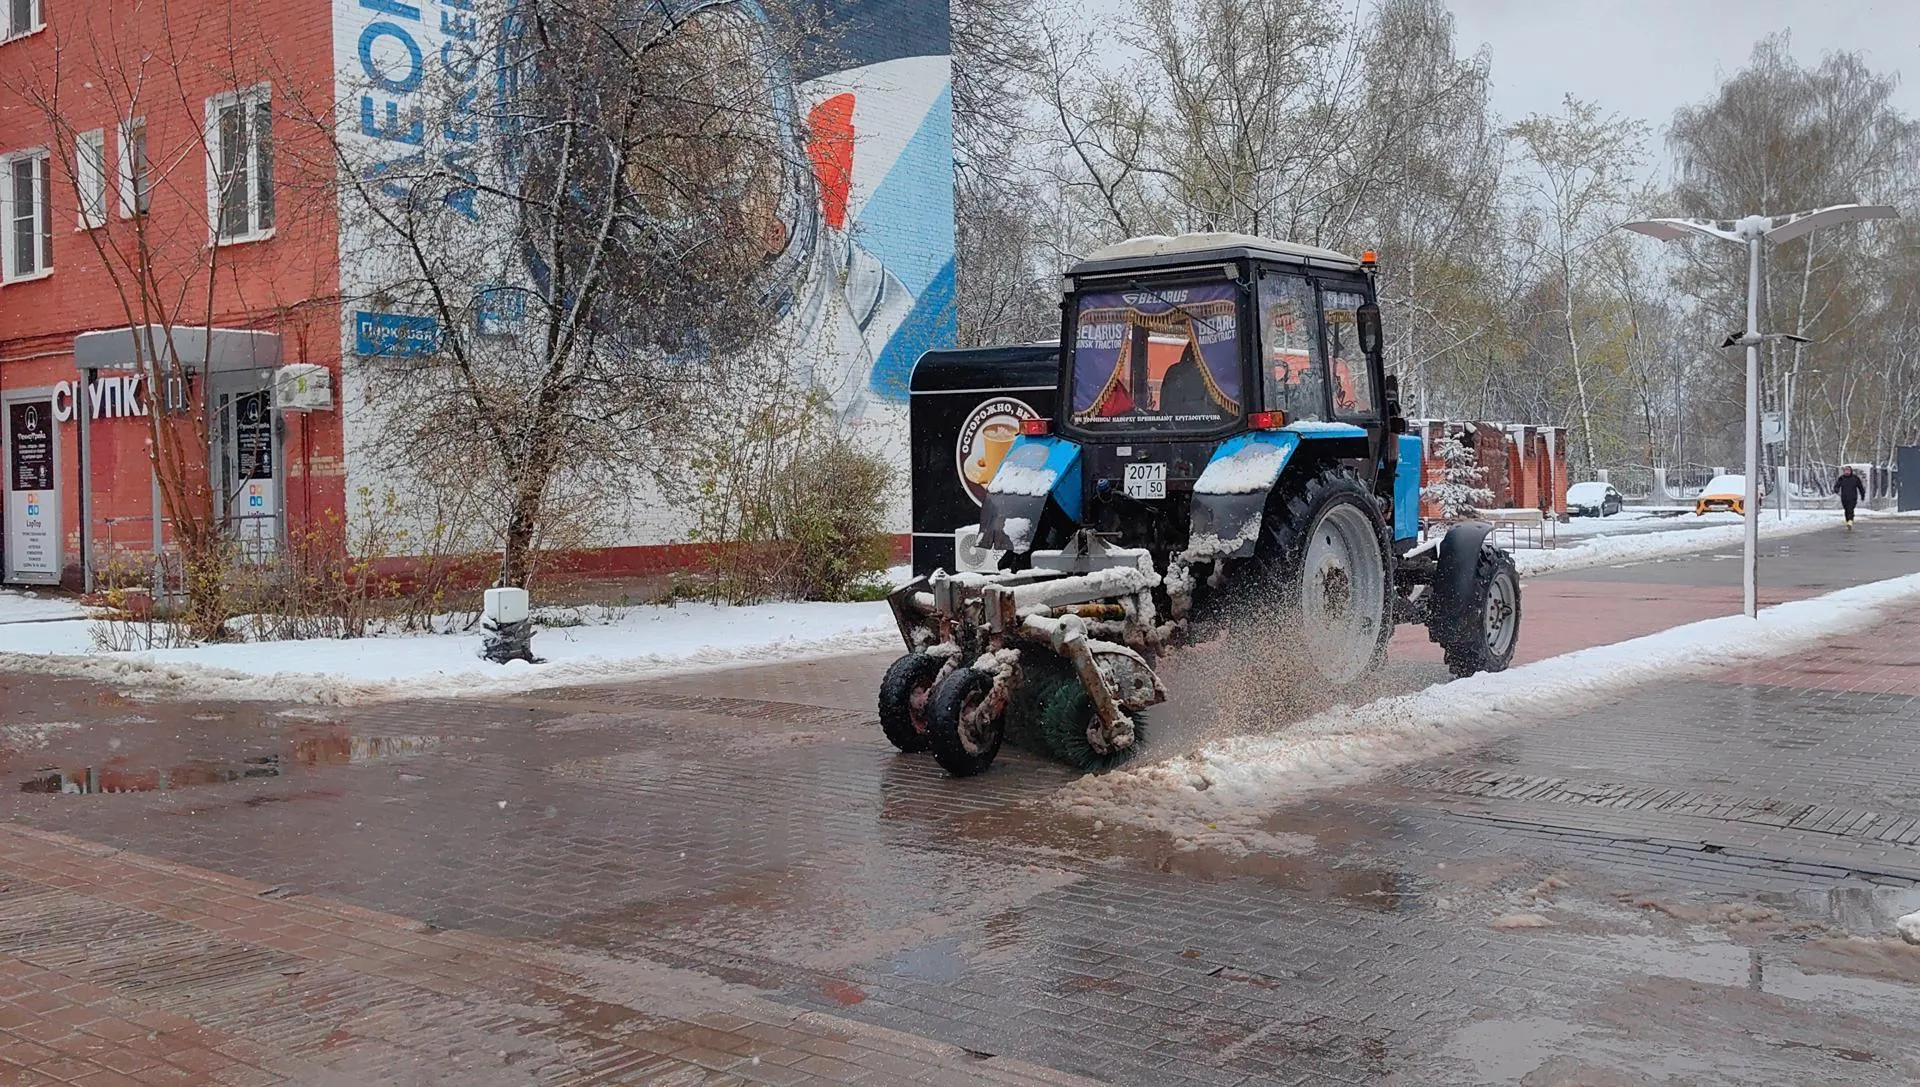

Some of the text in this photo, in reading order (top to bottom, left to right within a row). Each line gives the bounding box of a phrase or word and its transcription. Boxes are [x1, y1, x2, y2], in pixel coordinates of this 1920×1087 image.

[357, 0, 424, 212] ЛЕО
[1138, 290, 1189, 304] BELARUS
[1094, 339, 1122, 349] TRACTOR
[51, 376, 149, 422] СУПК
[962, 403, 1014, 453] ОСТОРОЖНО,
[1129, 465, 1160, 479] 2071
[1150, 482, 1163, 493] 50
